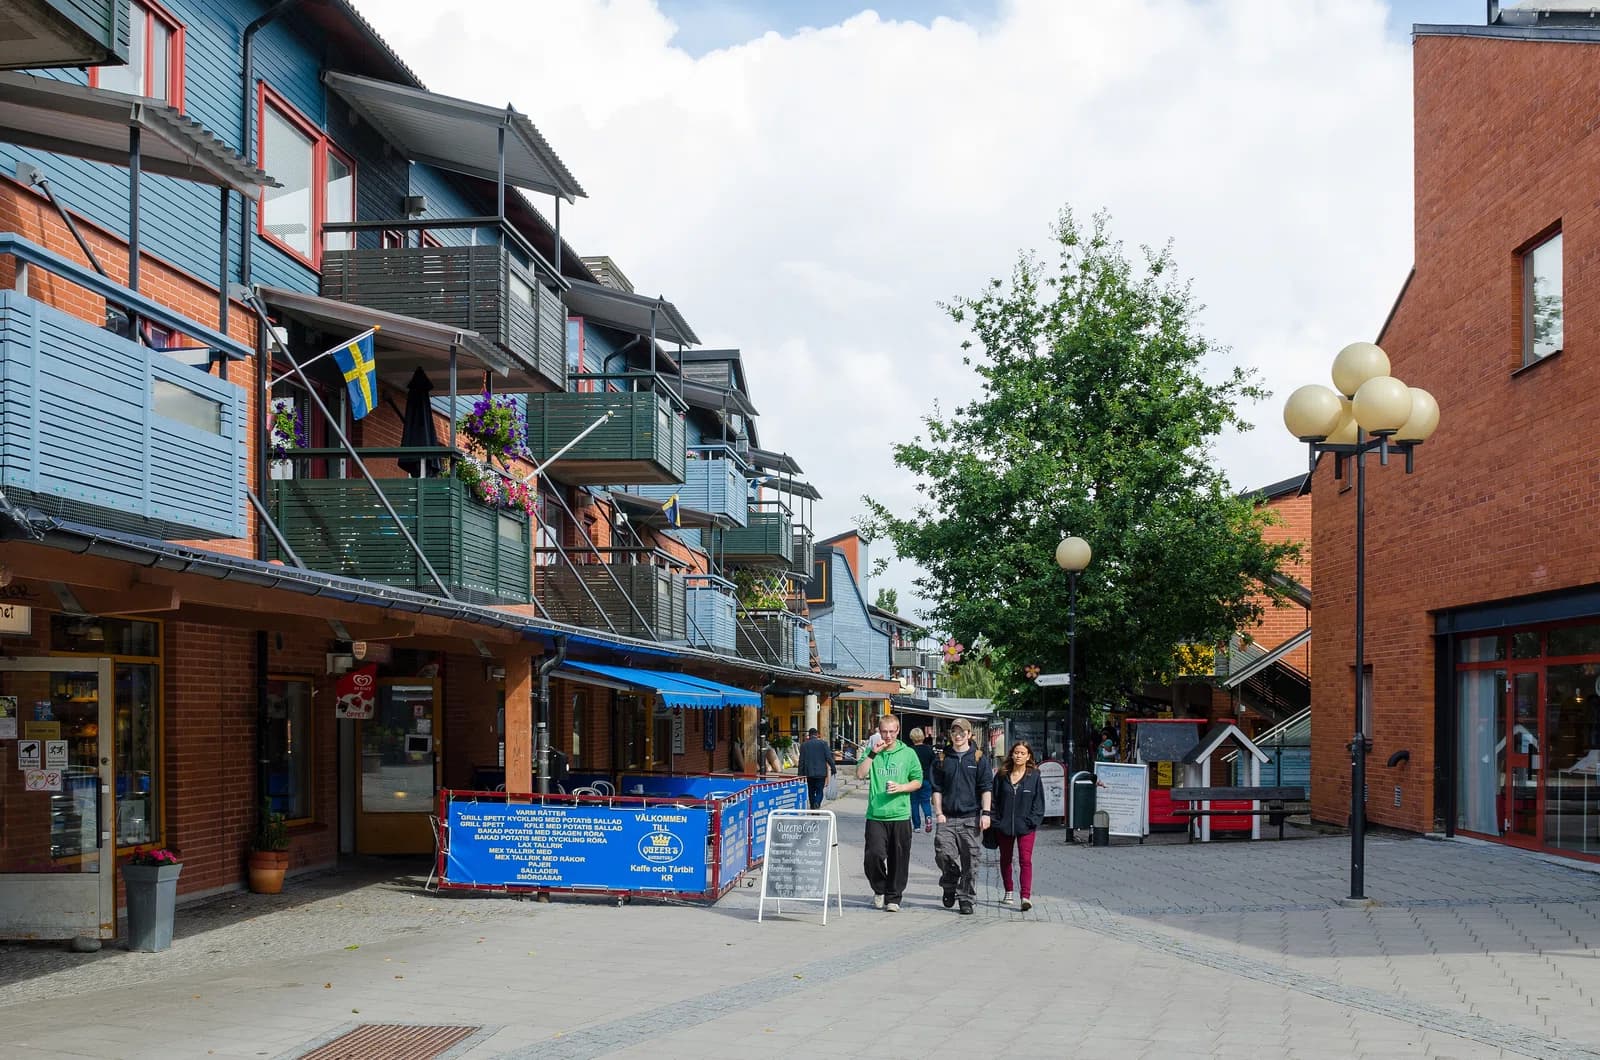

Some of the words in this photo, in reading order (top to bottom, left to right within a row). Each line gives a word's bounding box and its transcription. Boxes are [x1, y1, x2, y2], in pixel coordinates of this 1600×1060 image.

[635, 813, 688, 823] VÄLKOMMEN
[630, 864, 651, 872] Kaffe
[661, 874, 673, 882] KR
